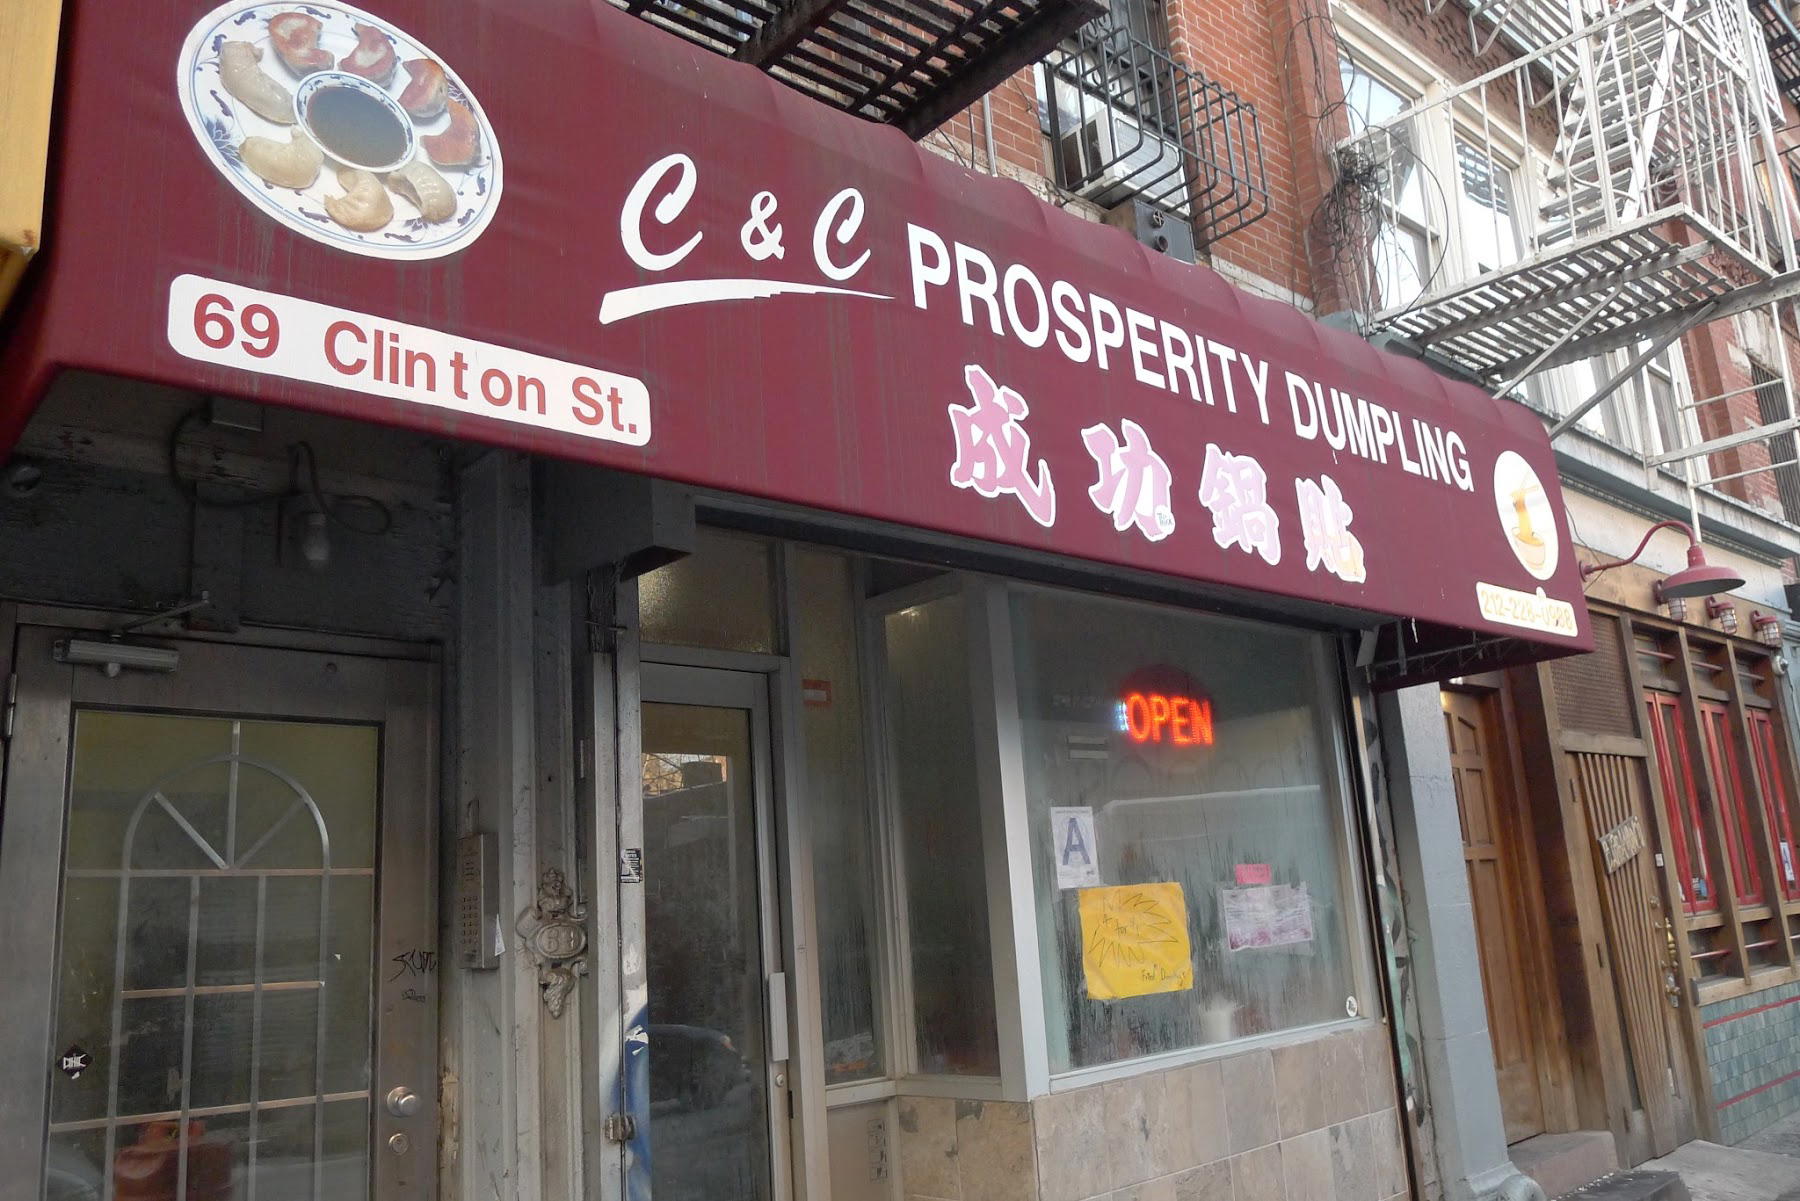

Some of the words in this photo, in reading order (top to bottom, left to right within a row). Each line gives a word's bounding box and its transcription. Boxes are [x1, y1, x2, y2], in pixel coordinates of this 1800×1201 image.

[193, 294, 280, 359] 69
[323, 321, 546, 415] Clinton
[571, 376, 640, 434] St.
[620, 153, 703, 272] C
[740, 190, 785, 261] &
[812, 187, 871, 281] C
[906, 222, 1270, 426] PROSPERITY
[1284, 370, 1475, 493] DUMPLING
[1125, 692, 1213, 746] OPEN
[1062, 816, 1091, 866] A
